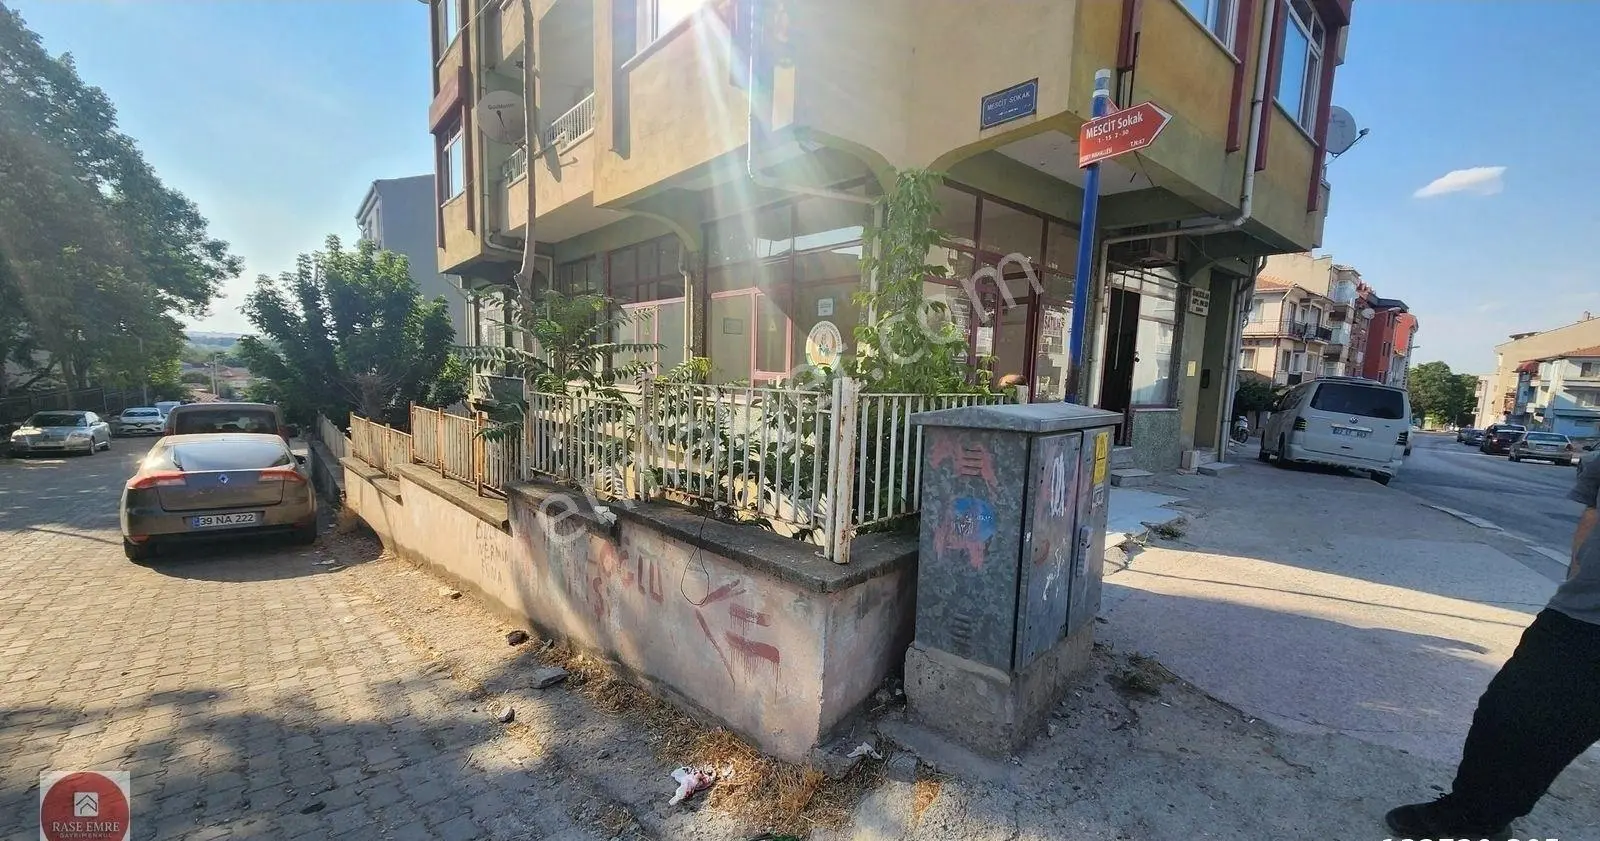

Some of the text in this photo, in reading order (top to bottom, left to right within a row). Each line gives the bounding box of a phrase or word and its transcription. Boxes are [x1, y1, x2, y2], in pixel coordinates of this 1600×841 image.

[987, 91, 1030, 110] MESCİT SOKAK
[1086, 111, 1143, 139] MESCİT Sokak
[200, 514, 254, 526] 39 NA 222
